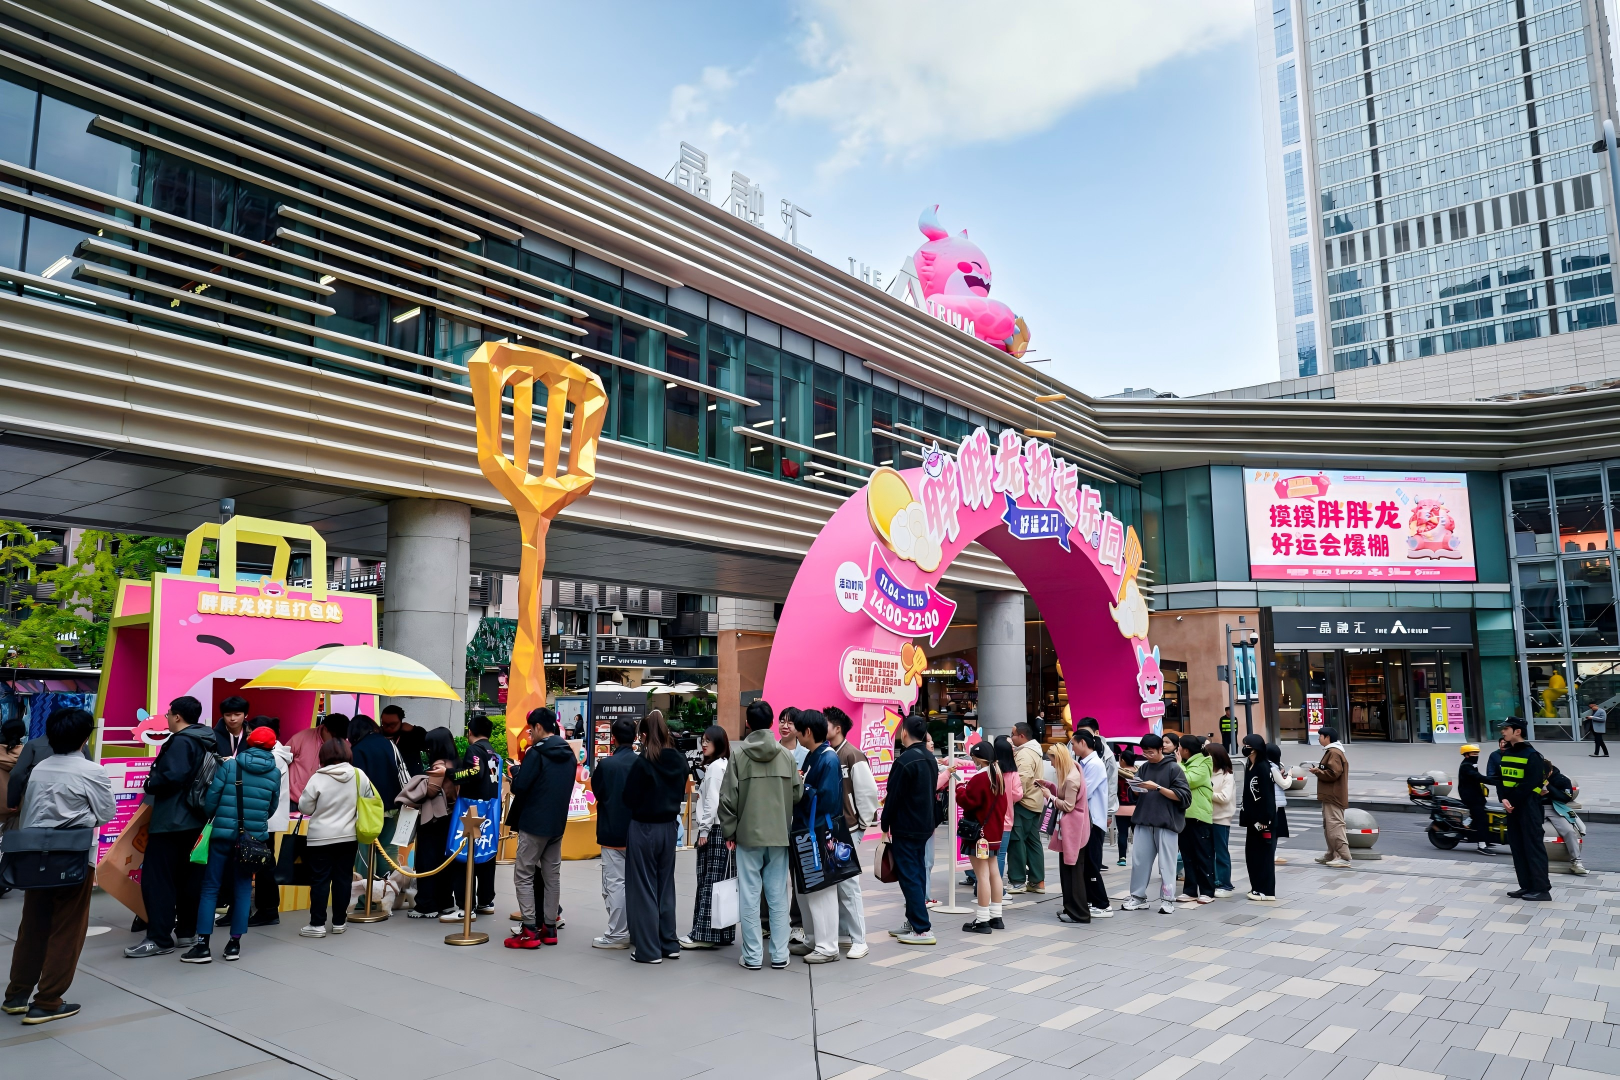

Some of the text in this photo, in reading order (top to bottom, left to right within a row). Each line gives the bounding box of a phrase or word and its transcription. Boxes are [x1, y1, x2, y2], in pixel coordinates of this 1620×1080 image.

[674, 141, 812, 254] 晶融汇
[848, 257, 881, 289] THE
[920, 427, 1124, 575] 胖胖龙好运乐园
[1269, 500, 1402, 529] 摸摸胖胖龙
[1019, 513, 1059, 534] 好运之门
[1271, 532, 1390, 557] 好运会爆棚
[844, 592, 859, 601] DATE
[879, 573, 899, 601] 11.04
[907, 593, 924, 607] 11.16
[201, 594, 342, 621] 胖胖龙好运打包处
[869, 589, 940, 631] 14:00-22:00
[1319, 621, 1367, 634] 晶融汇
[600, 655, 616, 663] FF
[663, 658, 677, 666] 中古
